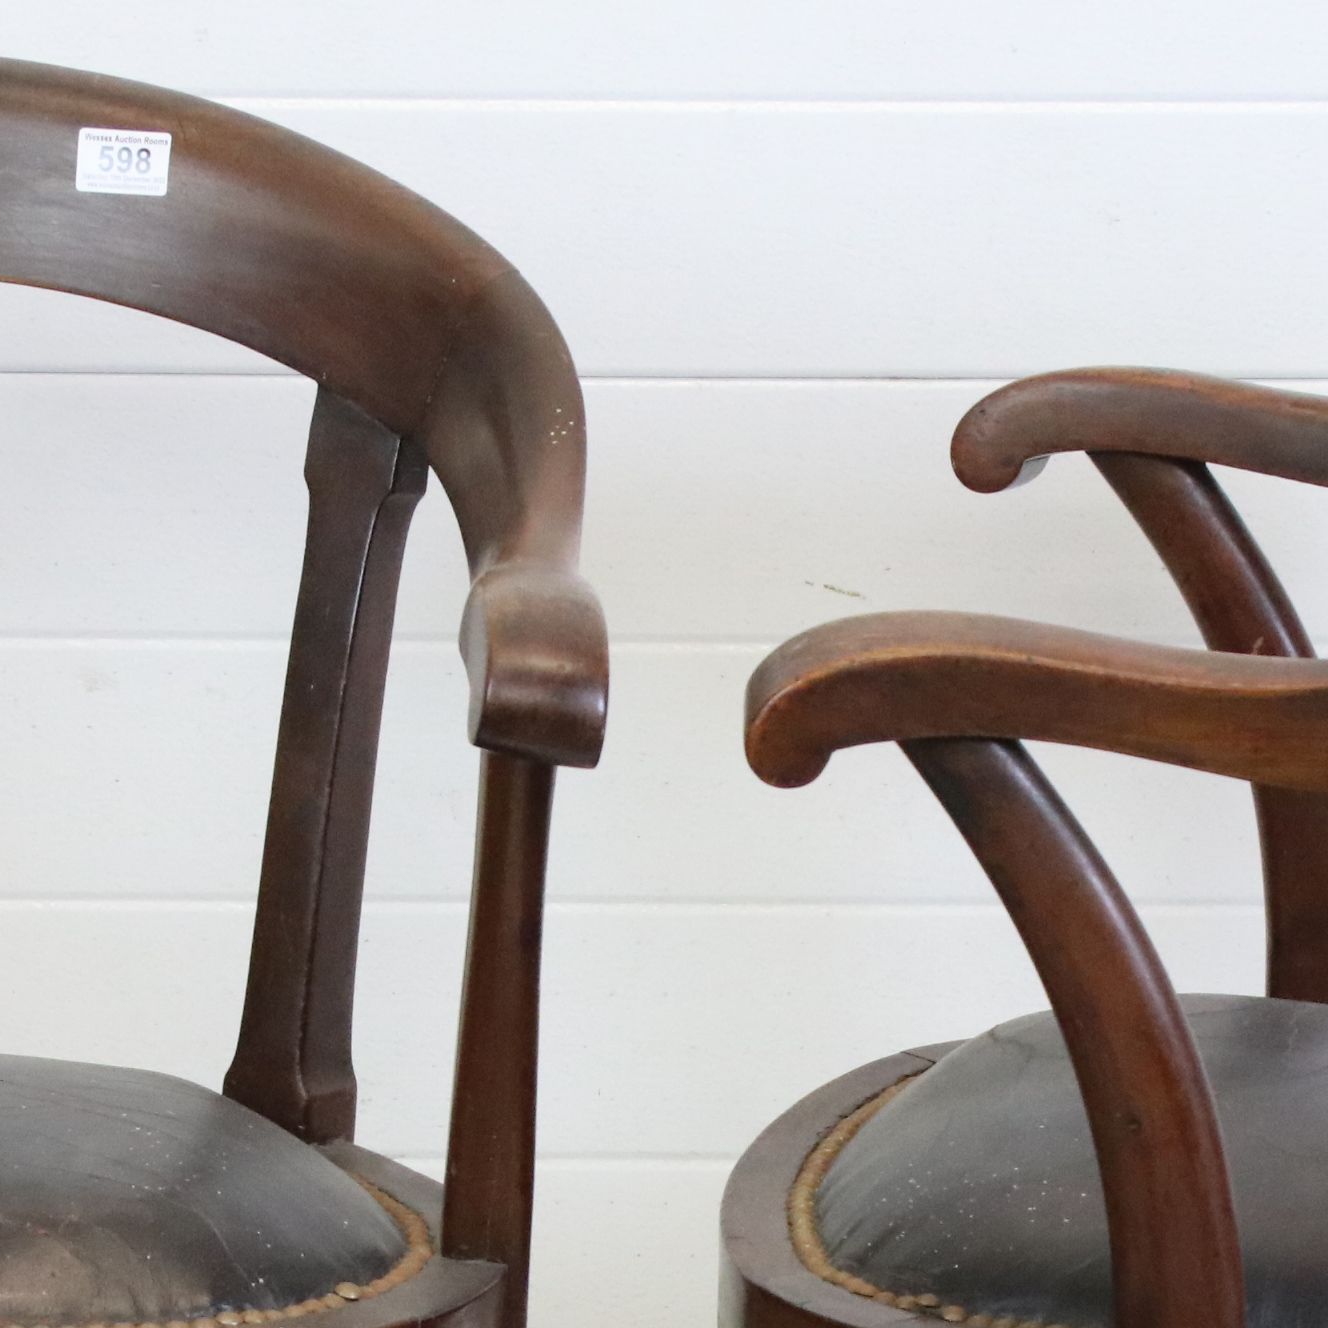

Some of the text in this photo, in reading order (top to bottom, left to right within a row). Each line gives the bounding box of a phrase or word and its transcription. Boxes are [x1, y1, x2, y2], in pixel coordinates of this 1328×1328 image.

[115, 135, 142, 144] Auction
[144, 136, 169, 145] Rooms
[98, 145, 152, 174] 598
